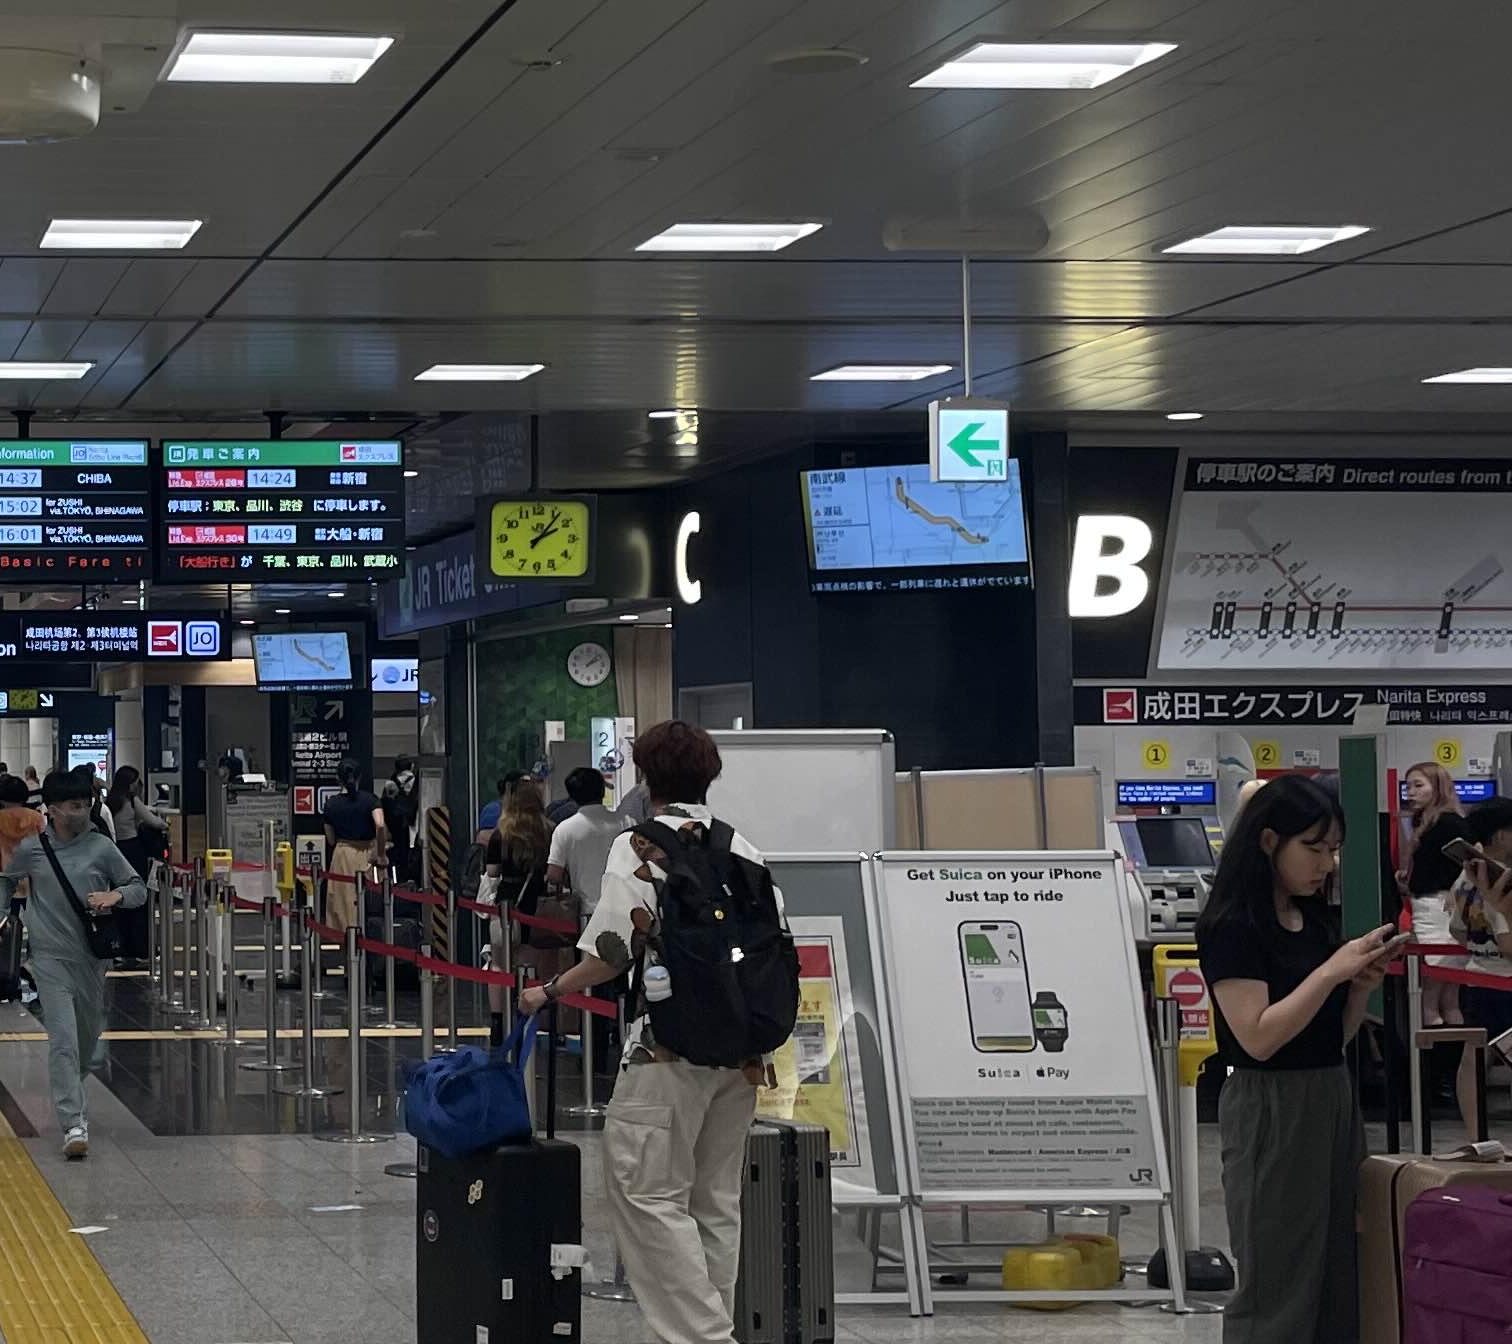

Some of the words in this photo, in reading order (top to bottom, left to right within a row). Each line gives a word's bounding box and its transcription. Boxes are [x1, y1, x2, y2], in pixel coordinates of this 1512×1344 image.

[0, 471, 37, 484] 14:37
[77, 473, 112, 484] CHIBA
[254, 471, 292, 484] 14:24
[1196, 463, 1336, 484] 停車駅のご案内
[1343, 468, 1395, 484] Direct
[1399, 468, 1455, 484] routes
[1460, 467, 1501, 485] from
[0, 500, 37, 513] 15:02
[96, 506, 144, 515] SHINAGAWA
[533, 506, 545, 516] 12
[506, 519, 519, 529] 10
[562, 519, 571, 528] 2
[0, 528, 37, 541] 16:01
[96, 534, 144, 543] SHINAGAWA
[254, 528, 293, 541] 14:49
[0, 556, 54, 567] Basic
[68, 556, 110, 567] Fare
[676, 512, 701, 604] C
[1068, 515, 1153, 617] B
[415, 565, 431, 611] JR
[435, 555, 476, 606] Ticket
[193, 632, 213, 645] JO
[1377, 689, 1422, 703] Narita
[1426, 689, 1486, 706] Express
[1143, 693, 1364, 720] 成田エクスプレス
[1467, 709, 1512, 721] 익스프레
[599, 732, 609, 746] 2
[907, 869, 935, 881] Get
[939, 868, 983, 881] Suica
[987, 871, 1006, 881] on
[1011, 870, 1045, 883] your
[1049, 868, 1103, 880] iPhone
[945, 890, 980, 903] Just
[984, 891, 1009, 904] tap
[1014, 891, 1030, 902] to
[1034, 890, 1064, 902] ride
[978, 1067, 1021, 1078] Suica
[1047, 1067, 1070, 1080] Pay
[1129, 1168, 1154, 1183] JR
